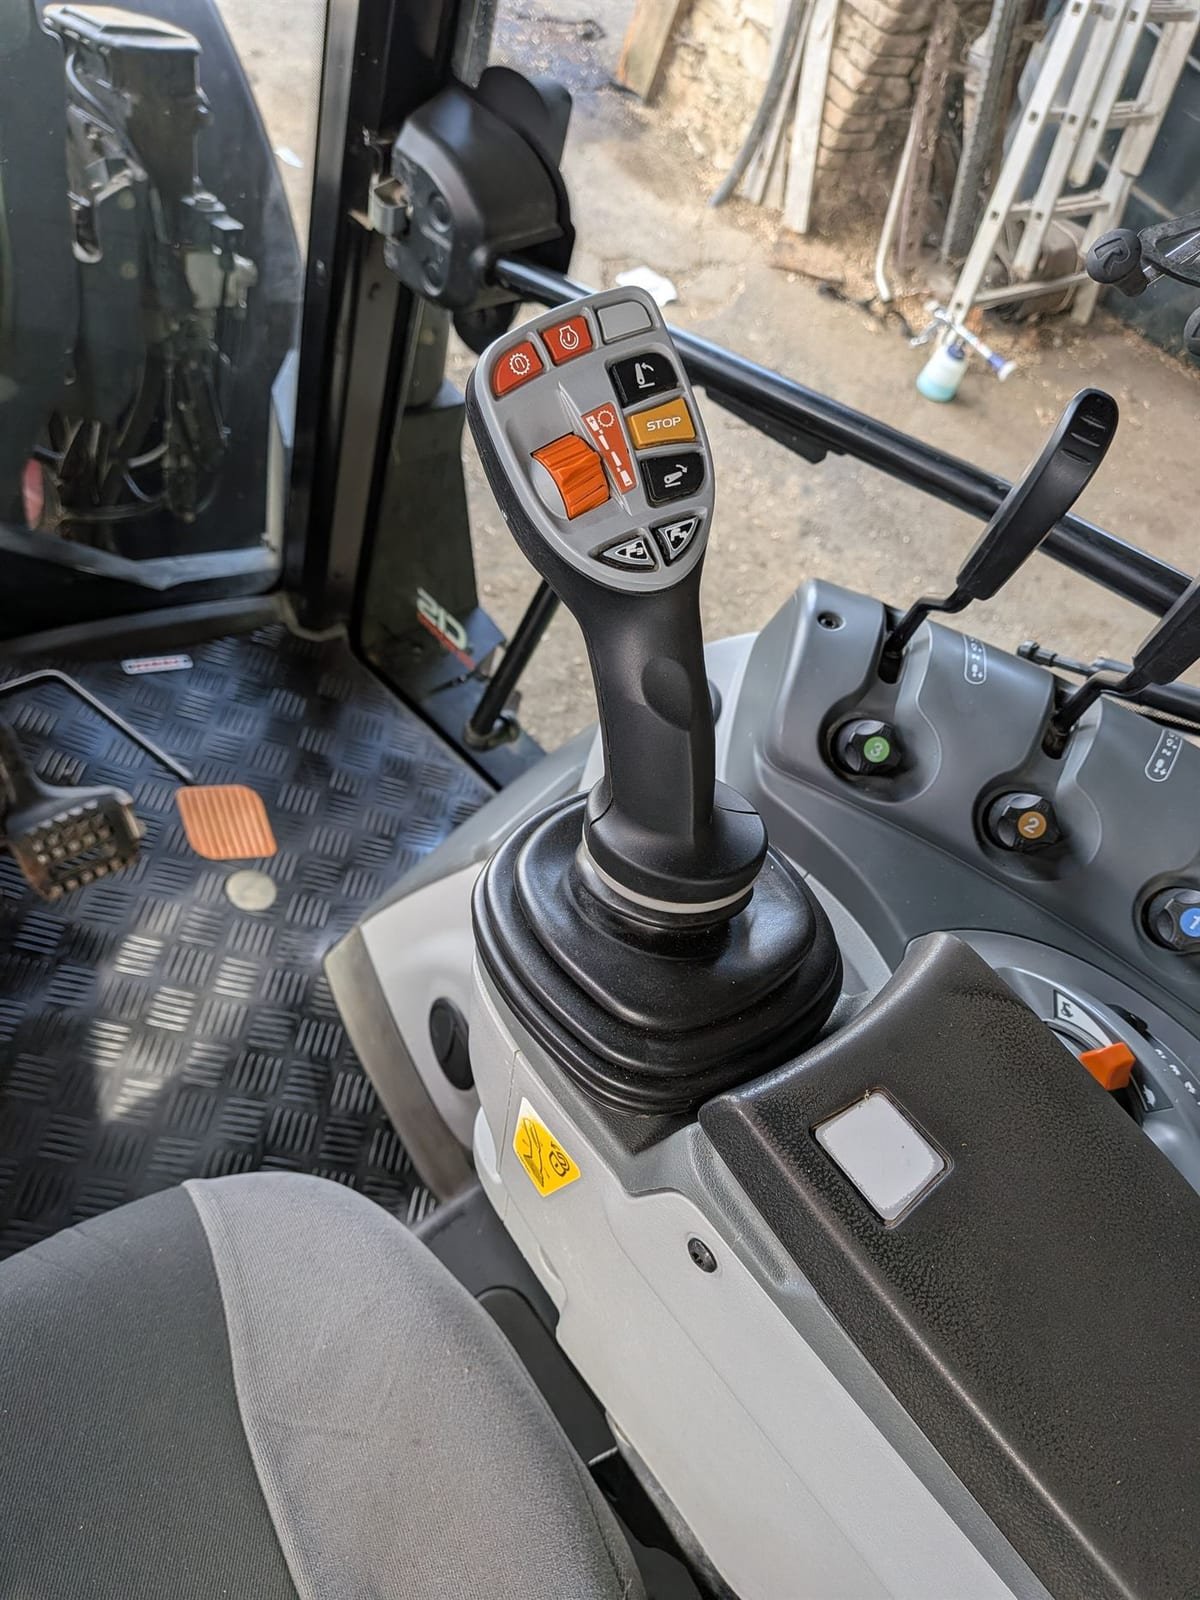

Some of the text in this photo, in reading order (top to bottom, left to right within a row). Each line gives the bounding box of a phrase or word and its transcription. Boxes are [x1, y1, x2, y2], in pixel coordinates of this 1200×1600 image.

[646, 416, 682, 431] STOP
[625, 544, 644, 557] F3
[870, 741, 884, 757] 3
[1023, 816, 1040, 833] 2
